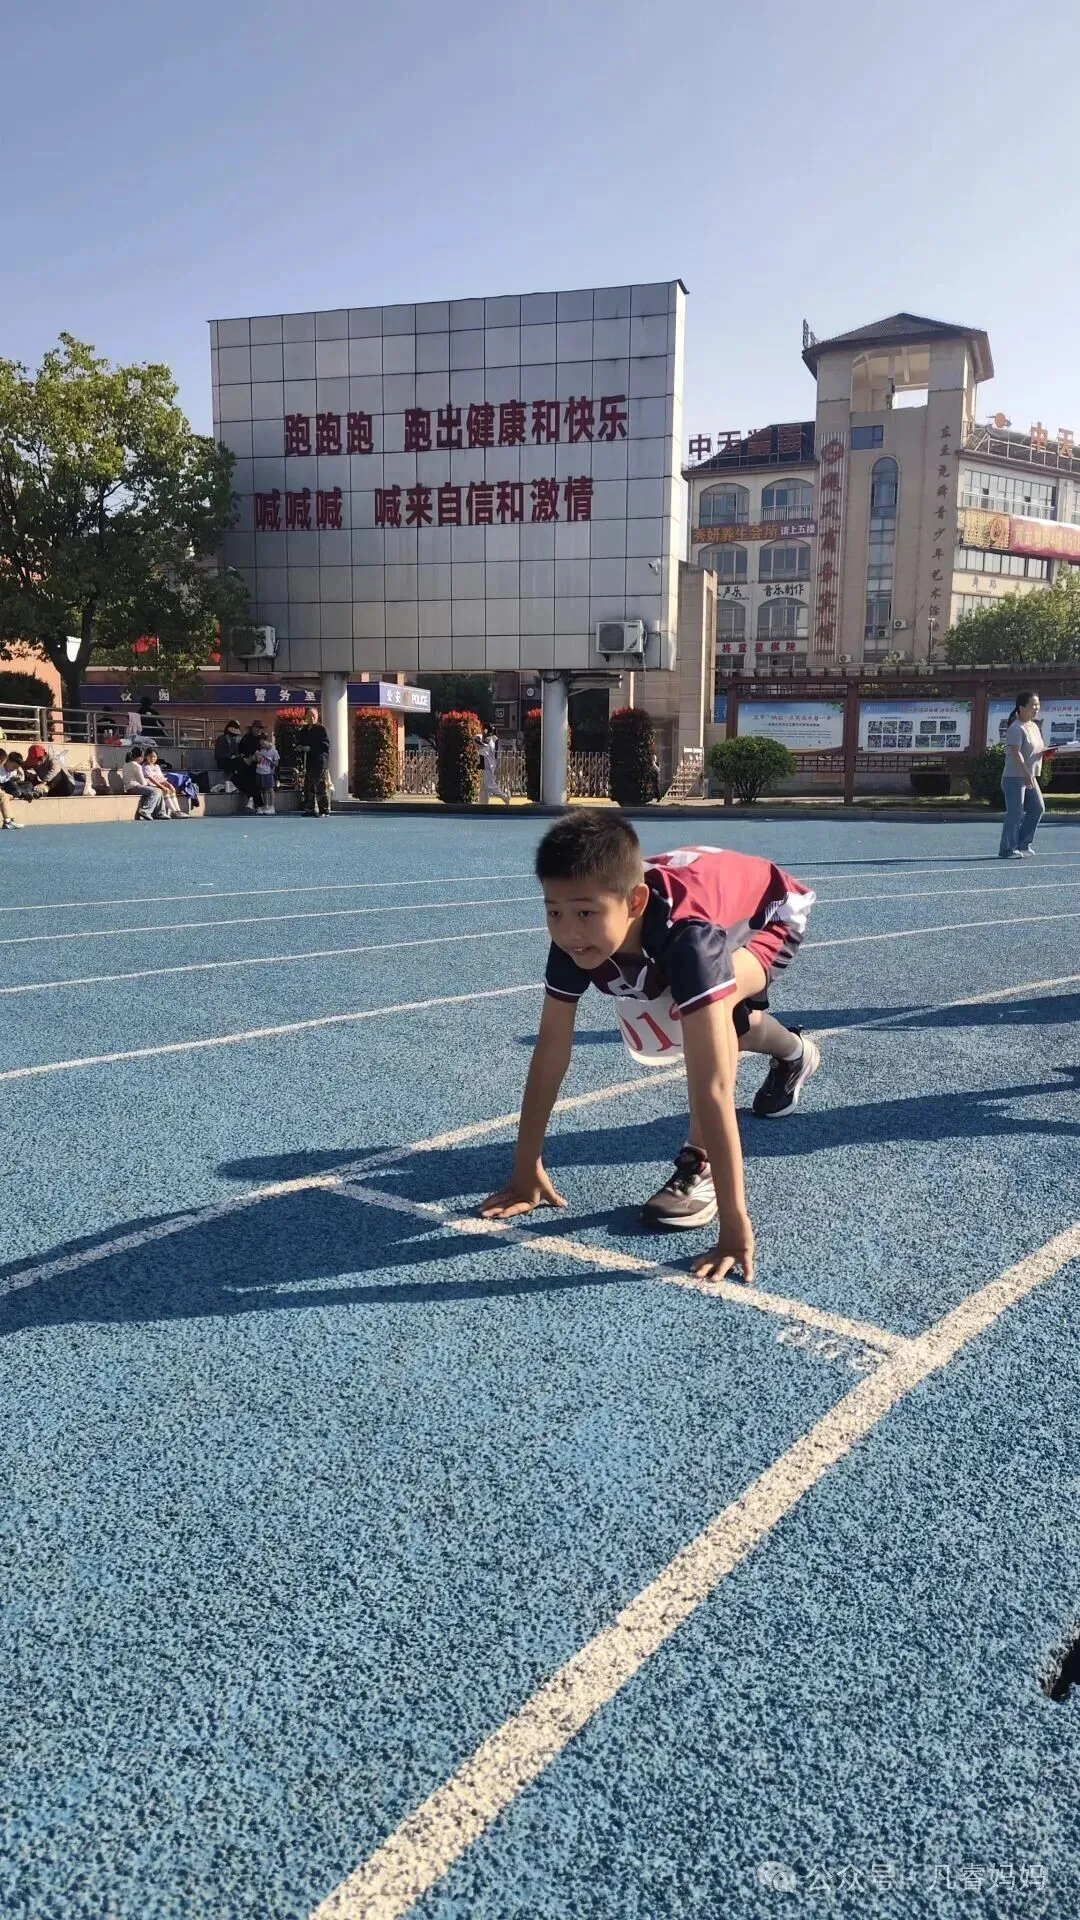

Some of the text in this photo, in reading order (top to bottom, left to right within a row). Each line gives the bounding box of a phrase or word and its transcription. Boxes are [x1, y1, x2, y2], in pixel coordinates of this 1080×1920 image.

[284, 395, 629, 457] 跑跑跑 跑出健康和快乐
[254, 475, 594, 531] 喊喊喊 喊来自信和激情
[763, 584, 804, 597] 音乐制作
[386, 689, 428, 706] 公安 POLICE
